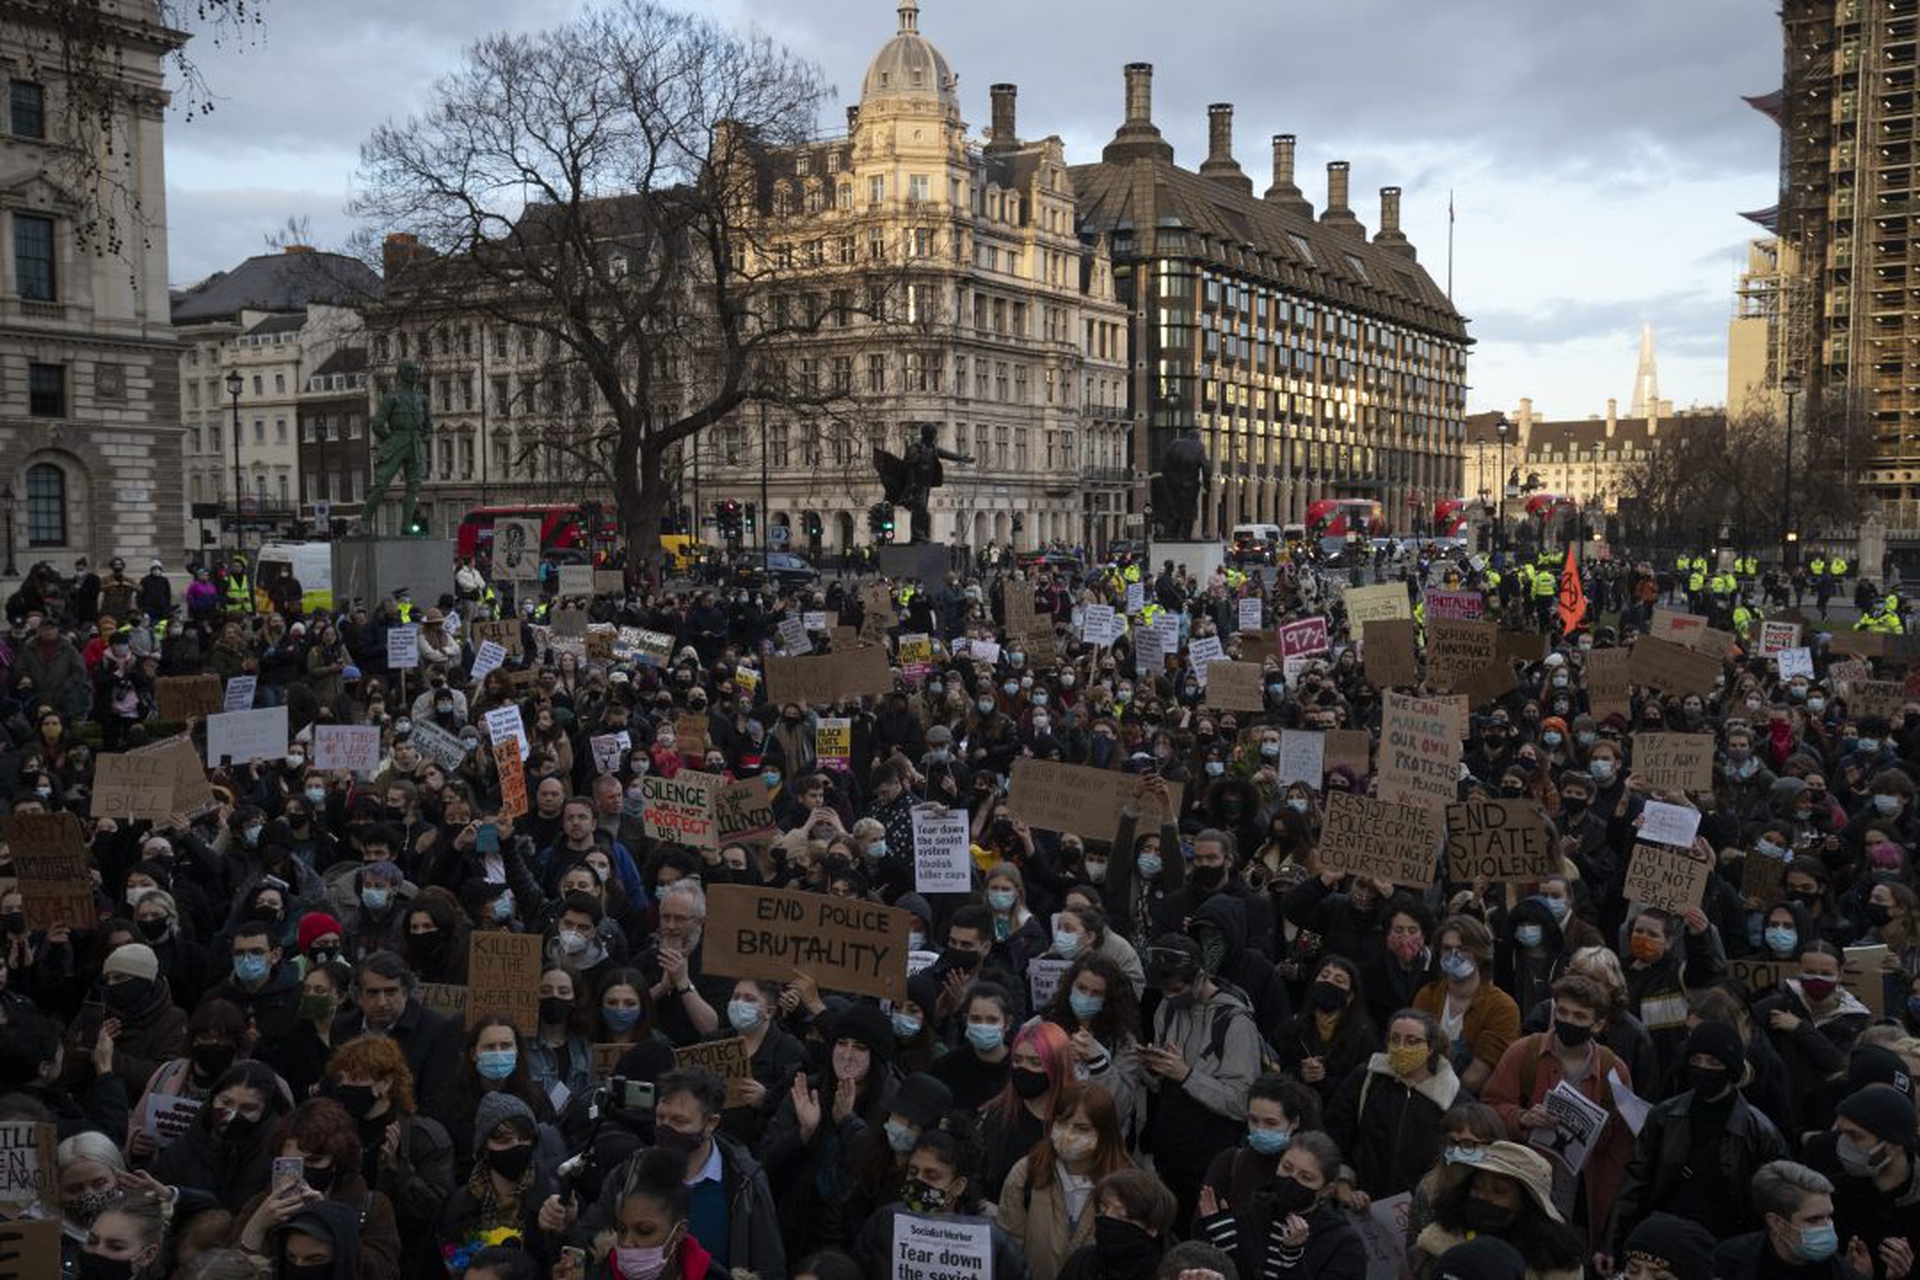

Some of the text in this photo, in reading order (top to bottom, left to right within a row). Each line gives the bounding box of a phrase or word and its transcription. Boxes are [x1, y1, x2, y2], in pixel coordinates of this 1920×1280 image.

[1286, 627, 1325, 650] 97%
[1411, 700, 1440, 716] CAN
[1390, 731, 1449, 758] OUR OWN
[1644, 752, 1668, 767] GET
[105, 795, 163, 812] BILL
[643, 778, 706, 808] SILENCE
[644, 809, 712, 836] PROTECT
[654, 801, 704, 818] WILL NOT
[1331, 792, 1428, 826] RESIST THE
[1446, 803, 1507, 832] END
[657, 826, 683, 843] US!
[917, 824, 965, 835] Tear down
[917, 836, 963, 845] the sexist
[1329, 810, 1435, 846] POLICE CRIME
[918, 847, 950, 857] system
[1322, 831, 1420, 862] SENTENCING
[1450, 828, 1538, 860] STATE
[1320, 850, 1430, 884] COURTS BILL
[1454, 856, 1548, 878] VIOLENCE
[1639, 847, 1700, 876] POLICE
[1633, 861, 1698, 891] DO NOT
[1627, 877, 1689, 904] KEEP US
[1640, 889, 1679, 913] SAFE
[757, 897, 890, 933] END POLICE
[474, 938, 531, 956] KILLED
[738, 929, 890, 977] BRUTALITY
[499, 957, 526, 973] THE
[677, 1040, 746, 1068] PROTECT
[910, 1224, 973, 1242] Socialist Worker
[899, 1242, 983, 1270] Tear down
[898, 1264, 923, 1280] the
